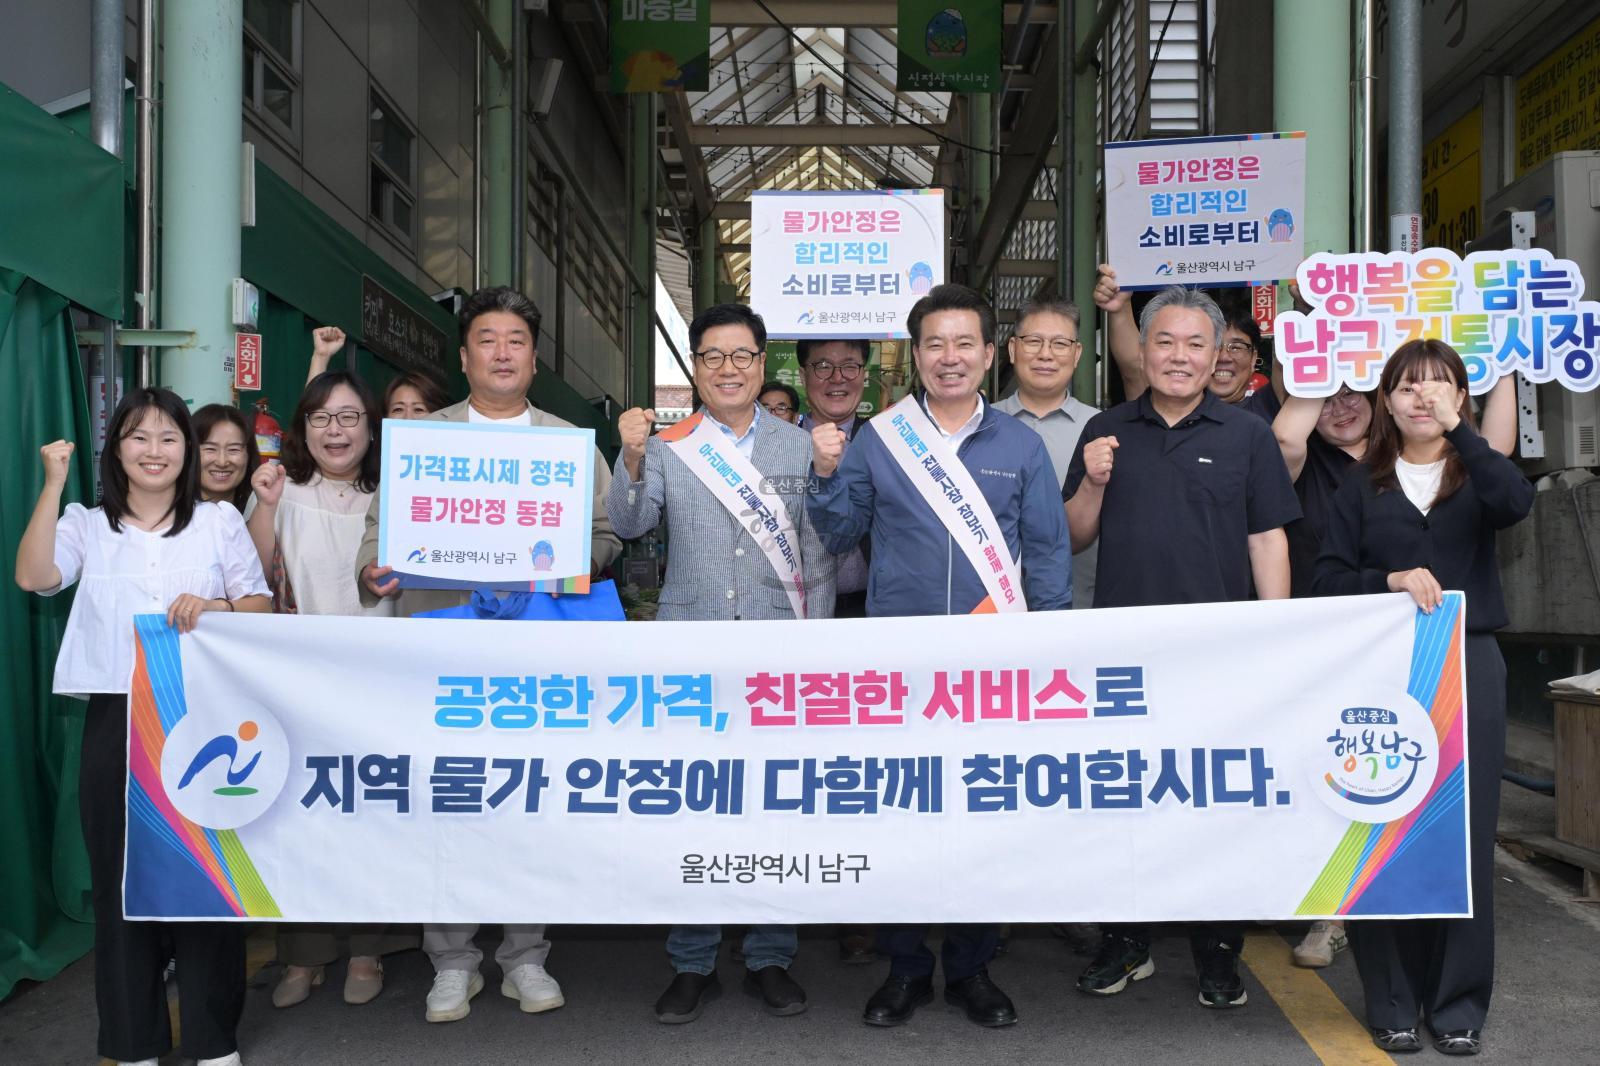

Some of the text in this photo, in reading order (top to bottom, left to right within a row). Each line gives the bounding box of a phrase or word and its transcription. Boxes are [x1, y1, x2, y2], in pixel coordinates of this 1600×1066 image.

[908, 71, 989, 88] 신정상가시장
[1137, 155, 1260, 186] 물가안정은
[1150, 189, 1247, 216] 합리적인
[783, 209, 901, 234] 물가안정은
[1139, 221, 1259, 248] 소비로부터
[795, 241, 888, 265] 합리적인
[1176, 259, 1256, 274] 울산광역시 남구
[782, 273, 900, 296] 소비로부터
[1306, 258, 1572, 317] 행복을 담는
[818, 311, 897, 324] 울산광역시 남구
[1255, 285, 1273, 320] 소화기
[240, 337, 257, 374] 소화기
[1283, 319, 1383, 384] 남구
[399, 454, 577, 488] 가격표시제 정착
[410, 495, 564, 528] 물가안정 동참
[736, 483, 779, 533] 전통시장
[774, 531, 797, 573] 장보기
[921, 454, 963, 505] 전통시장
[956, 503, 989, 545] 장보기
[983, 544, 1004, 574] 함께
[430, 549, 518, 565] 울산광역시 남구
[433, 665, 1148, 732] 공정한 가격, 친절한 서비스로
[1326, 728, 1428, 781] 행복남구
[300, 747, 1291, 816] 지역 물가 안정에 다함께 참여합시다.
[680, 852, 872, 885] 울산광역시 남구
